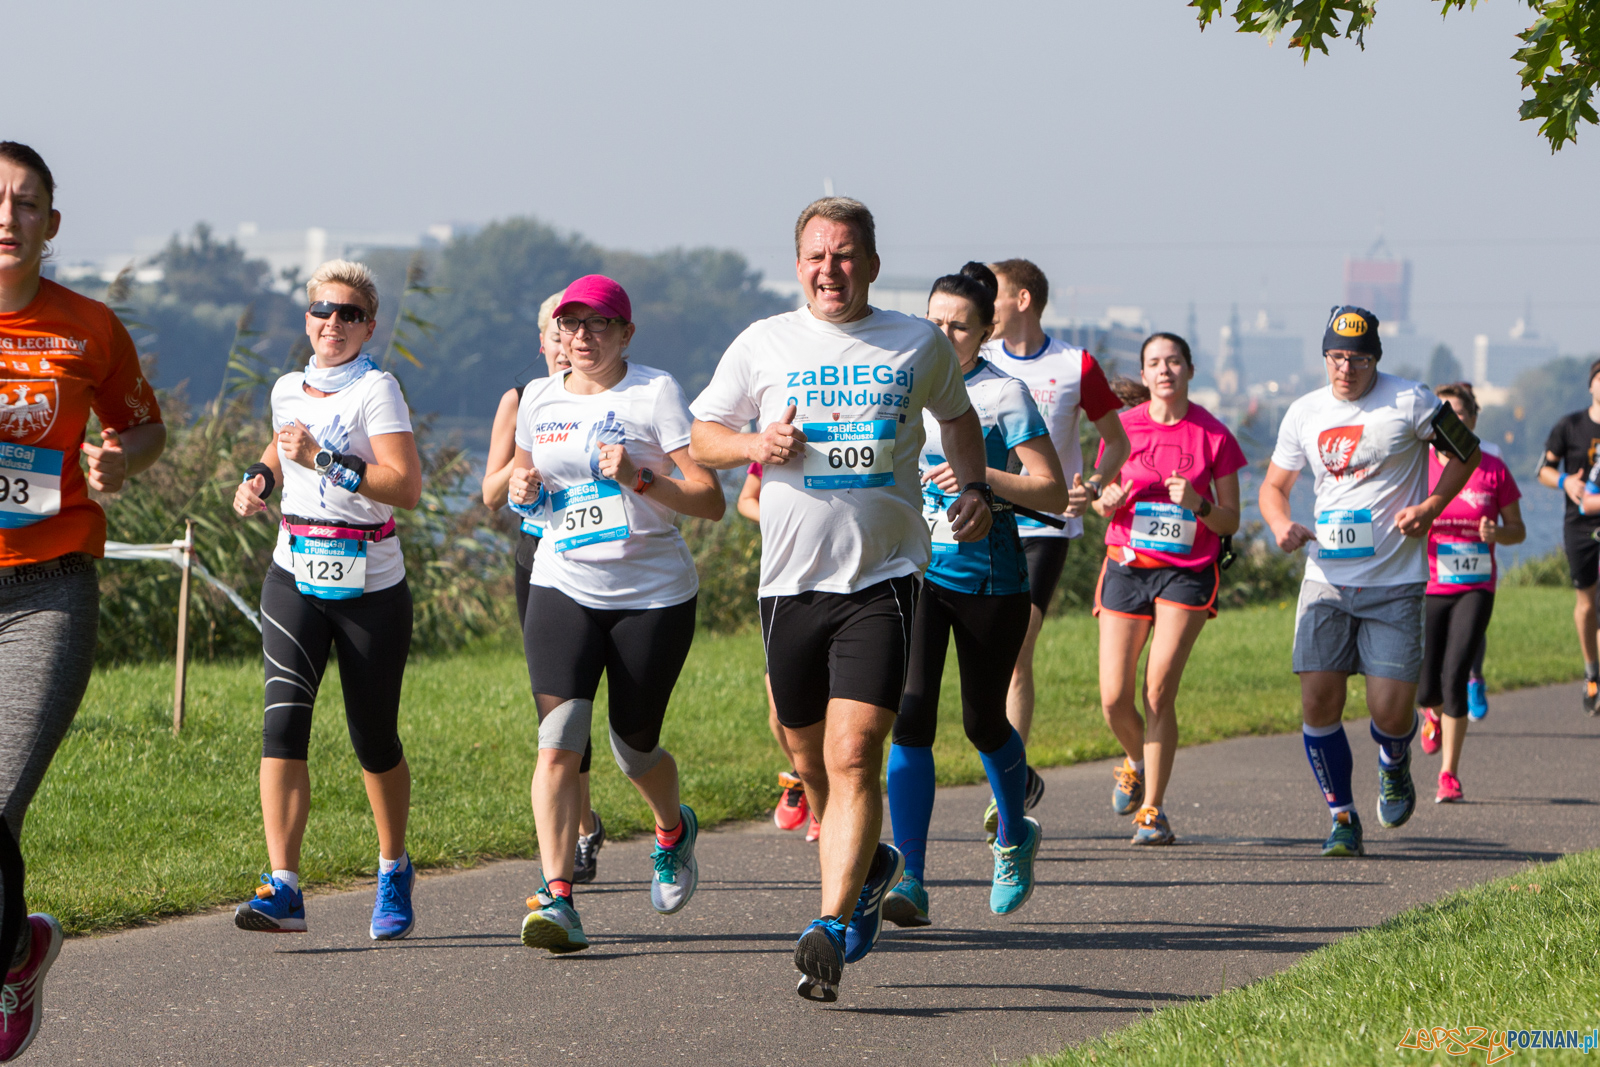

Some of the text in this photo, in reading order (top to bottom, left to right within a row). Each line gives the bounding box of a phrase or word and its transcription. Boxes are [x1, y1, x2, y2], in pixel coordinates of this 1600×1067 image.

[1337, 318, 1366, 333] Buff
[786, 365, 914, 393] zaBIEGaj
[806, 389, 910, 409] FUNdusze
[827, 423, 874, 433] zaBIEGaj
[535, 432, 569, 445] TEAM
[834, 433, 874, 441] FUNdusze
[0, 444, 36, 463] IEGaj
[828, 446, 875, 469] 609
[0, 475, 29, 505] 93
[564, 483, 598, 500] zaBIEGaj
[565, 505, 603, 531] 579
[1149, 521, 1181, 538] 258
[1329, 528, 1356, 544] 410
[305, 539, 346, 550] zaBIEGaj
[306, 560, 344, 581] 123
[1453, 558, 1479, 571] 147
